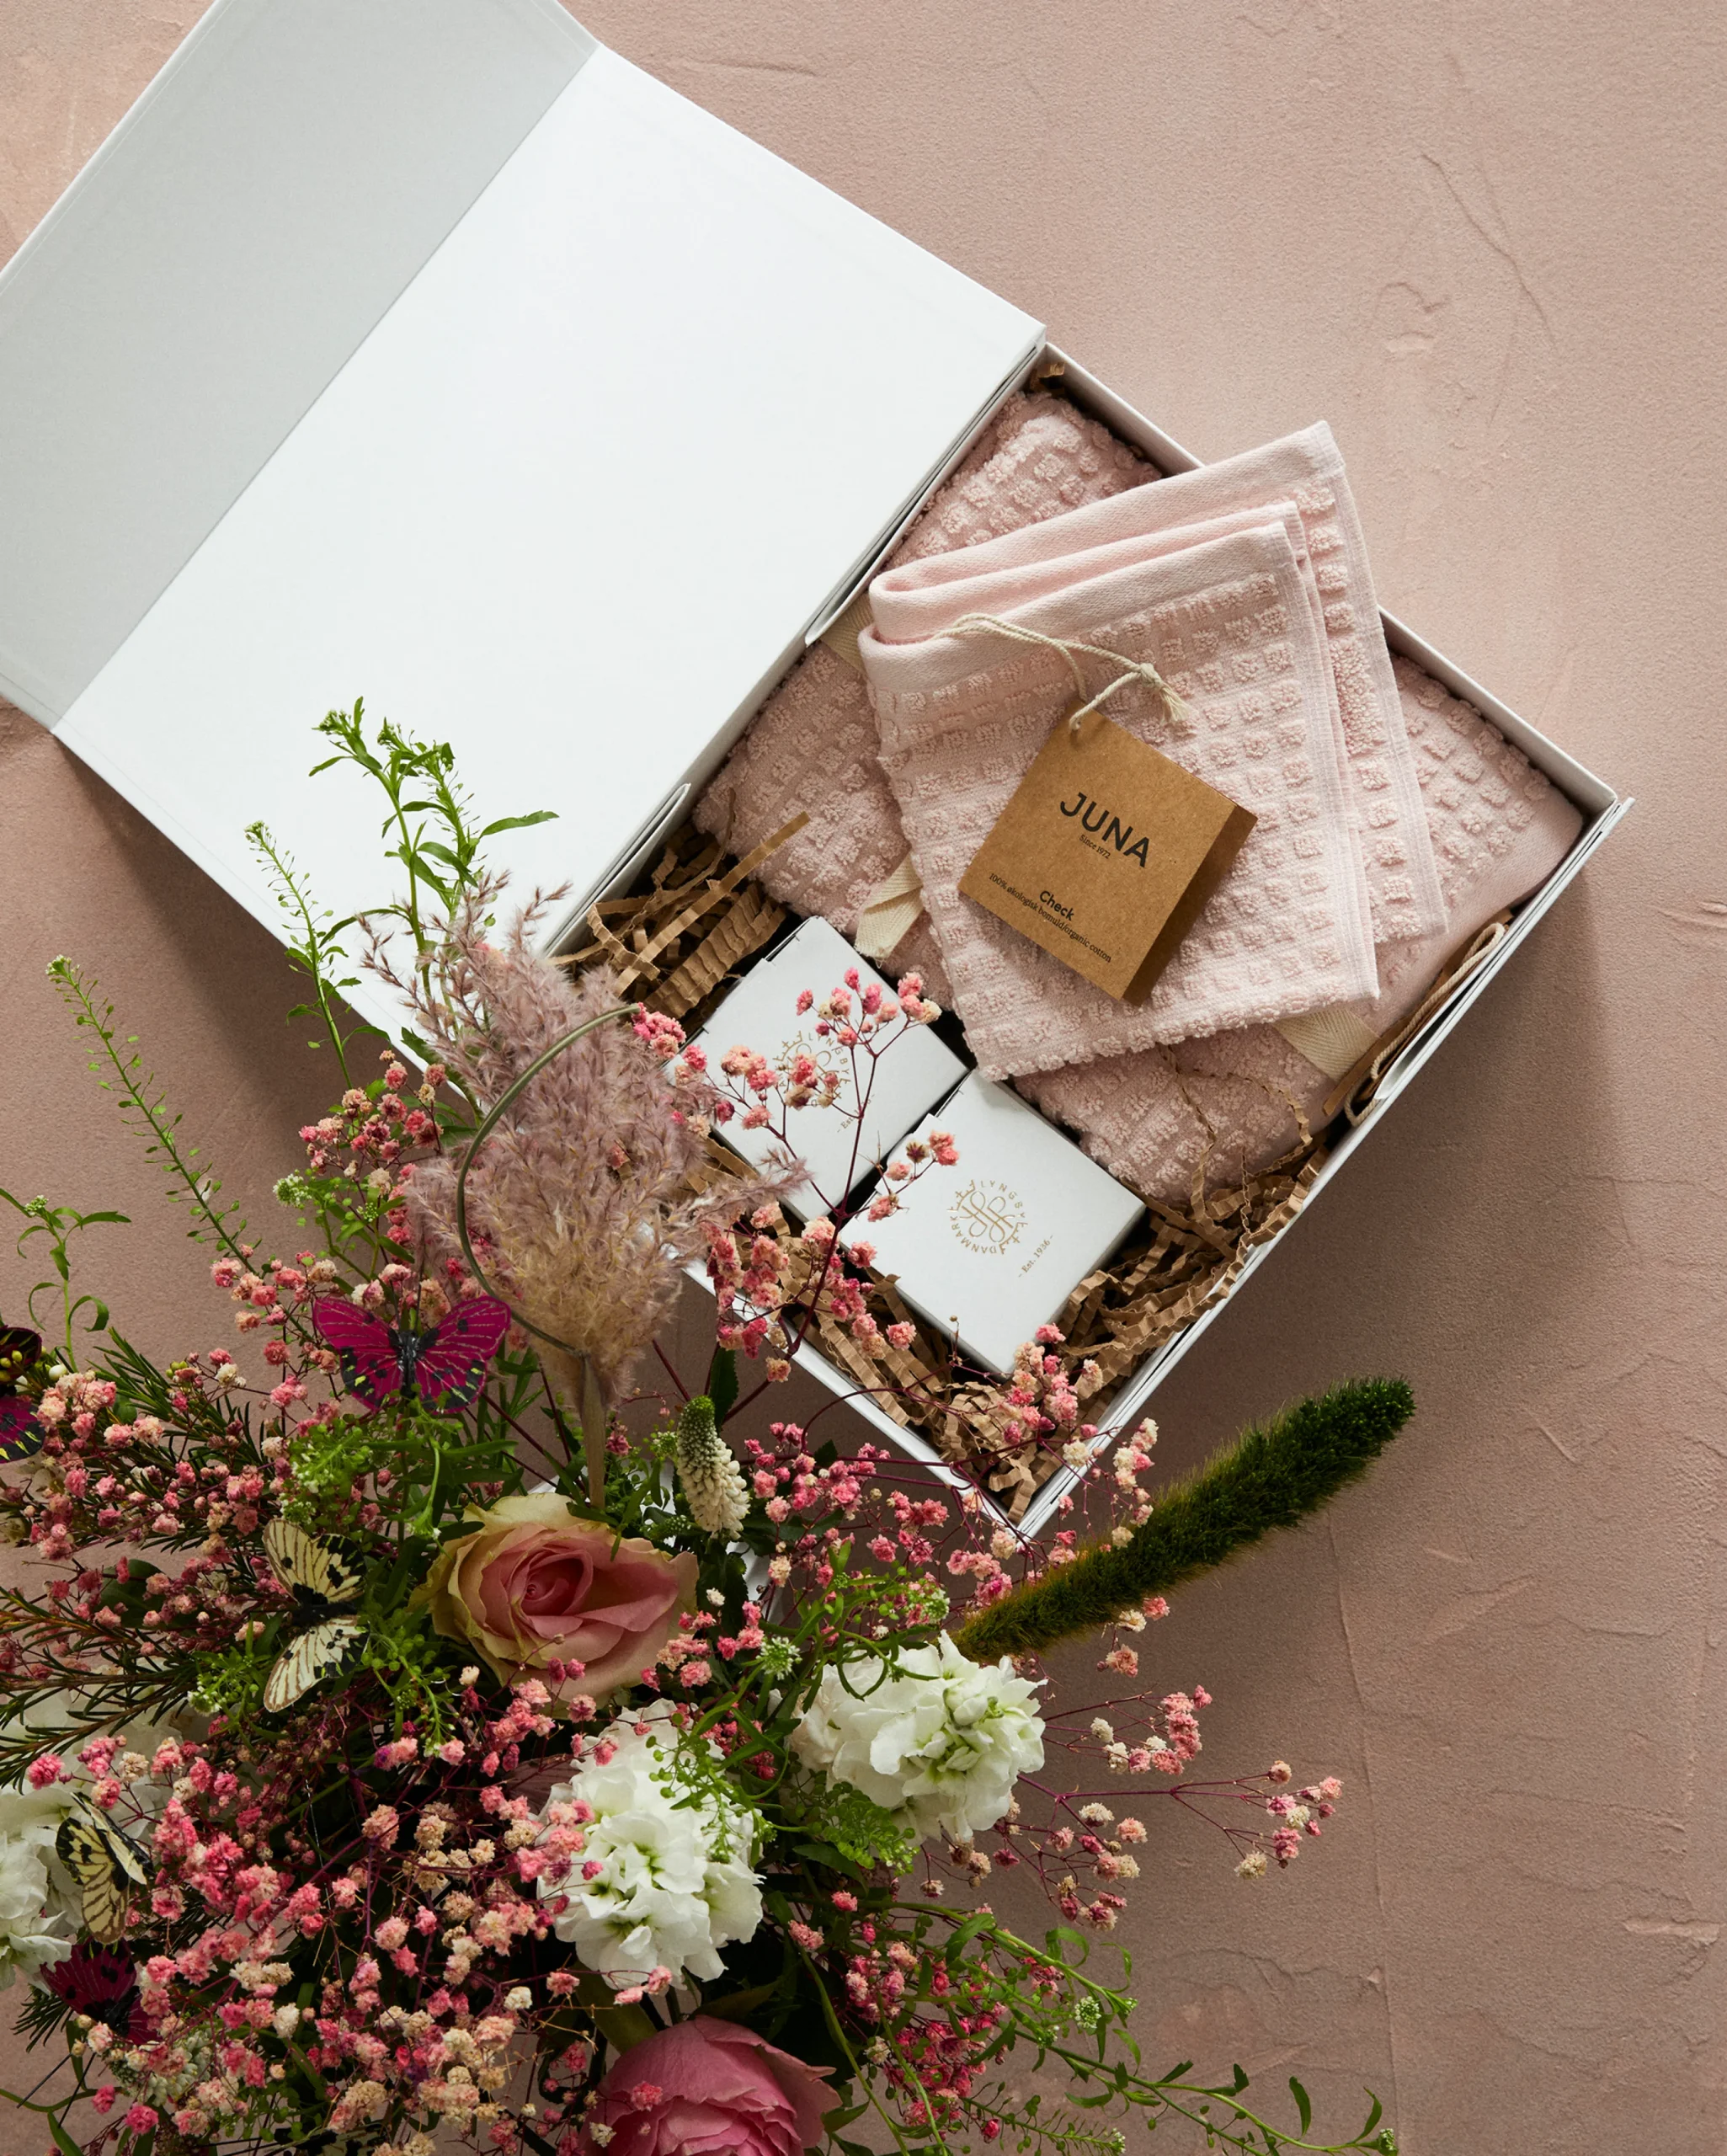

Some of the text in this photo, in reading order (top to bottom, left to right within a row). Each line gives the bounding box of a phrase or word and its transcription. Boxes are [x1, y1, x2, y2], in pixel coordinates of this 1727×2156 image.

[1060, 792, 1151, 868] JUNA
[1079, 834, 1111, 859] Since 1972
[989, 873, 1112, 963] 100% økologisk bomuld/organic cotton
[1039, 890, 1075, 921] Check
[950, 1215, 997, 1254] DANMARK
[1021, 1239, 1051, 1273] Est. 1936
